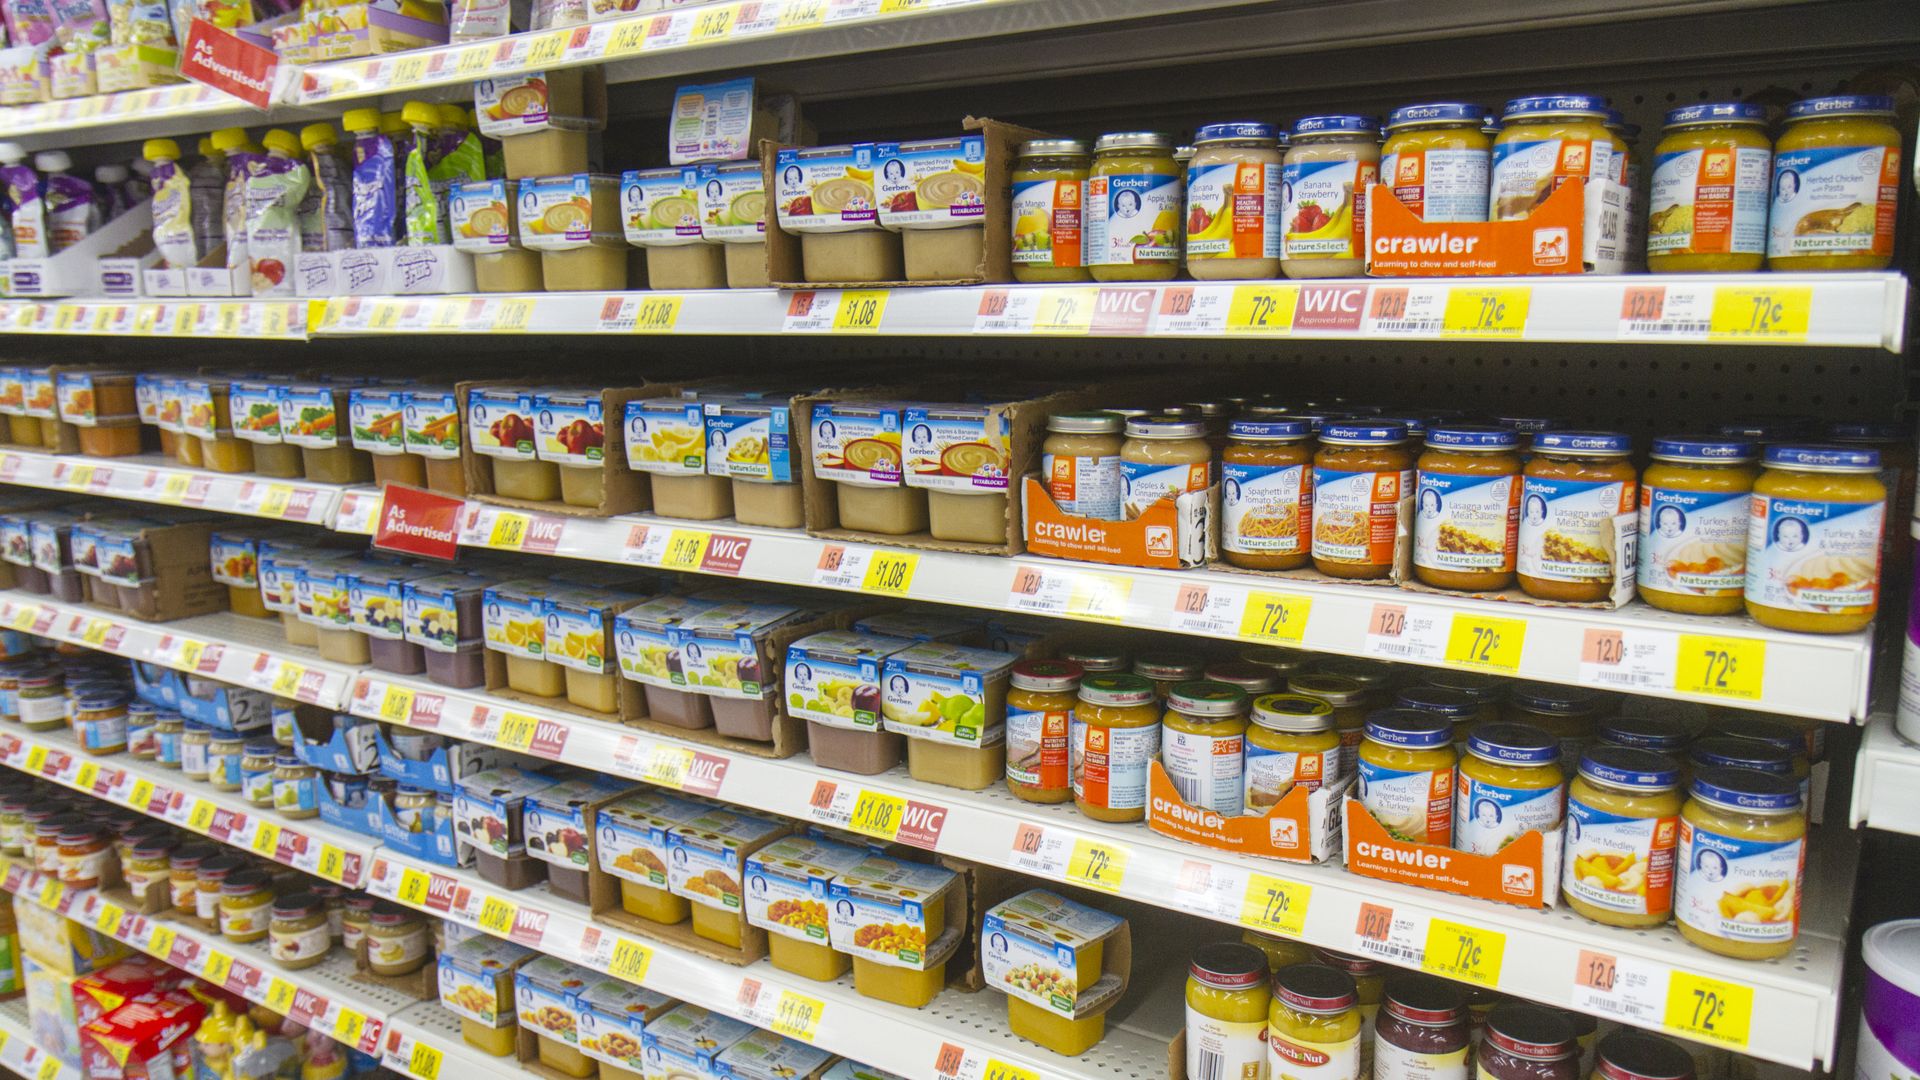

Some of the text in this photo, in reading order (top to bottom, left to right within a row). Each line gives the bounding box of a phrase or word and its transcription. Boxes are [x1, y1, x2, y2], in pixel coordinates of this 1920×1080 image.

[194, 39, 214, 56] As
[192, 50, 265, 93] Advertised
[1556, 98, 1590, 110] Gerber
[1815, 99, 1854, 111] Gerber
[1407, 108, 1440, 119] Gerber
[1672, 110, 1702, 121] Gerber
[1236, 126, 1266, 137] Gerber
[1297, 120, 1325, 131] Gerber
[1505, 159, 1530, 170] Mixed
[1777, 155, 1812, 168] Gerber
[1112, 178, 1149, 188] Gerber
[1303, 181, 1332, 190] Banana
[1805, 173, 1864, 185] Herbed Chicken
[782, 189, 807, 197] Gerber
[882, 183, 910, 192] Gerber
[1298, 188, 1340, 200] Strawberry
[1288, 240, 1348, 252] NatureSelect
[1375, 231, 1479, 254] crawler
[1794, 237, 1871, 248] NatureSelect
[1374, 259, 1497, 270] Learning to chew and self-feed
[1101, 291, 1151, 314] WIC
[1303, 290, 1362, 312] WIC
[846, 298, 878, 325] $1.08
[1249, 295, 1277, 326] 72¢
[1477, 297, 1507, 328] 72¢
[1751, 296, 1784, 329] 72¢
[1300, 316, 1356, 326] Approved item
[708, 419, 735, 429] Gerber
[1241, 425, 1270, 434] Gerber
[1330, 428, 1359, 438] Gerber
[1434, 433, 1462, 443] Gerber
[818, 442, 840, 450] Gerber
[1572, 439, 1609, 448] Gerber
[908, 447, 936, 456] Gerber
[1702, 446, 1738, 457] Gerber
[1797, 452, 1840, 464] Gerber
[1223, 466, 1248, 478] Gerber
[1136, 480, 1166, 491] Apples &
[1420, 475, 1452, 488] Gerber
[1525, 480, 1558, 494] Gerber
[1247, 487, 1290, 497] Spaghetti in
[1655, 491, 1698, 505] Gerber
[1245, 496, 1294, 505] Tomato Sauce
[388, 504, 406, 519] As
[1252, 504, 1268, 514] with
[1449, 501, 1501, 515] Lasagna with
[1555, 508, 1610, 521] Lasagna with
[1774, 503, 1823, 517] Gerber
[1451, 510, 1498, 521] Meat Sauce
[1557, 517, 1601, 528] Meat Sauc
[386, 518, 453, 543] Advertised
[531, 520, 560, 541] WIC
[1035, 520, 1107, 544] crawler
[711, 538, 748, 561] WIC
[1238, 537, 1295, 548] NatureSelect
[1437, 553, 1500, 565] NatureSelect
[876, 560, 907, 588] $1.08
[1541, 563, 1608, 575] NatureSelect
[1801, 591, 1873, 603] NatureSelect
[1261, 602, 1290, 635] 72¢
[1470, 626, 1501, 662] 72¢
[1703, 650, 1738, 688] 72¢
[793, 682, 816, 693] Gerber
[415, 696, 442, 717] WIC
[888, 694, 913, 706] Gerber
[536, 722, 566, 744] WIC
[1378, 729, 1408, 743] Gerber
[1499, 749, 1533, 761] Gerber
[691, 758, 723, 782] WIC
[1594, 766, 1627, 782] Gerber
[1383, 782, 1407, 794] Mixed
[1474, 783, 1513, 801] Gerber
[1375, 789, 1416, 804] Vegetables
[1737, 795, 1776, 808] Gerber
[1378, 799, 1411, 813] & Turkey
[1524, 803, 1547, 814] Mixed
[857, 798, 894, 829] $1.08
[902, 804, 944, 833] WIC
[1153, 796, 1226, 831] crawler
[1584, 831, 1636, 854] Fruit Medley
[1696, 832, 1740, 854] Gerber
[1357, 840, 1452, 870] crawler
[1084, 848, 1111, 881] 72¢
[1357, 860, 1469, 888] Learning to chew and self-feed
[1734, 866, 1790, 882] Fruit Medley
[428, 879, 453, 900] WIC
[1574, 881, 1638, 906] NatureSelect
[1263, 888, 1291, 924] 72¢
[518, 911, 546, 932] WIC
[834, 917, 859, 929] Gerber
[1720, 920, 1789, 935] NatureSelect
[616, 943, 645, 974] $1.08
[988, 949, 1012, 967] Gerber
[1454, 935, 1482, 970] 72¢
[777, 999, 813, 1031] $1.08
[1692, 989, 1725, 1032] 72¢
